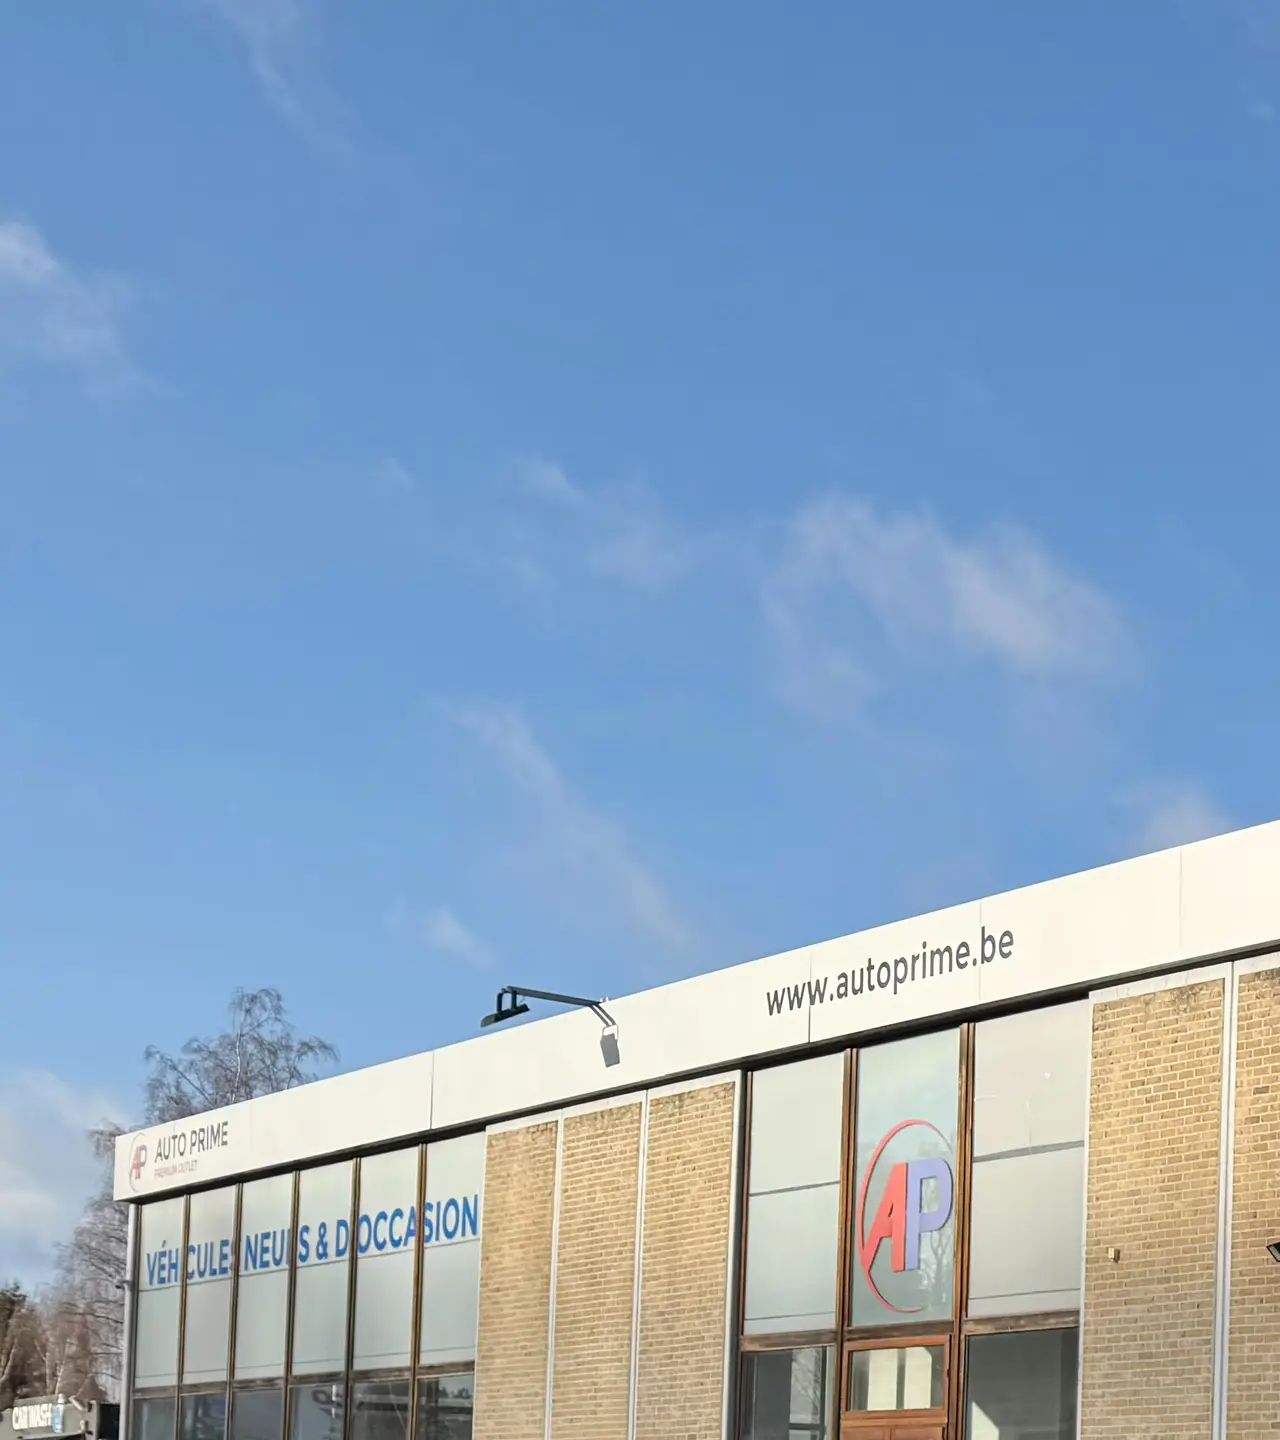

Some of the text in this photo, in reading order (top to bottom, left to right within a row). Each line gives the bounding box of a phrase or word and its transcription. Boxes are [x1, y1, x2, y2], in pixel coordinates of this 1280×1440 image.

[766, 925, 1014, 1016] www.autoprime.be
[154, 1121, 228, 1162] AUTO PRIME
[316, 1221, 328, 1260] &
[12, 1402, 52, 1430] CAR WASH
